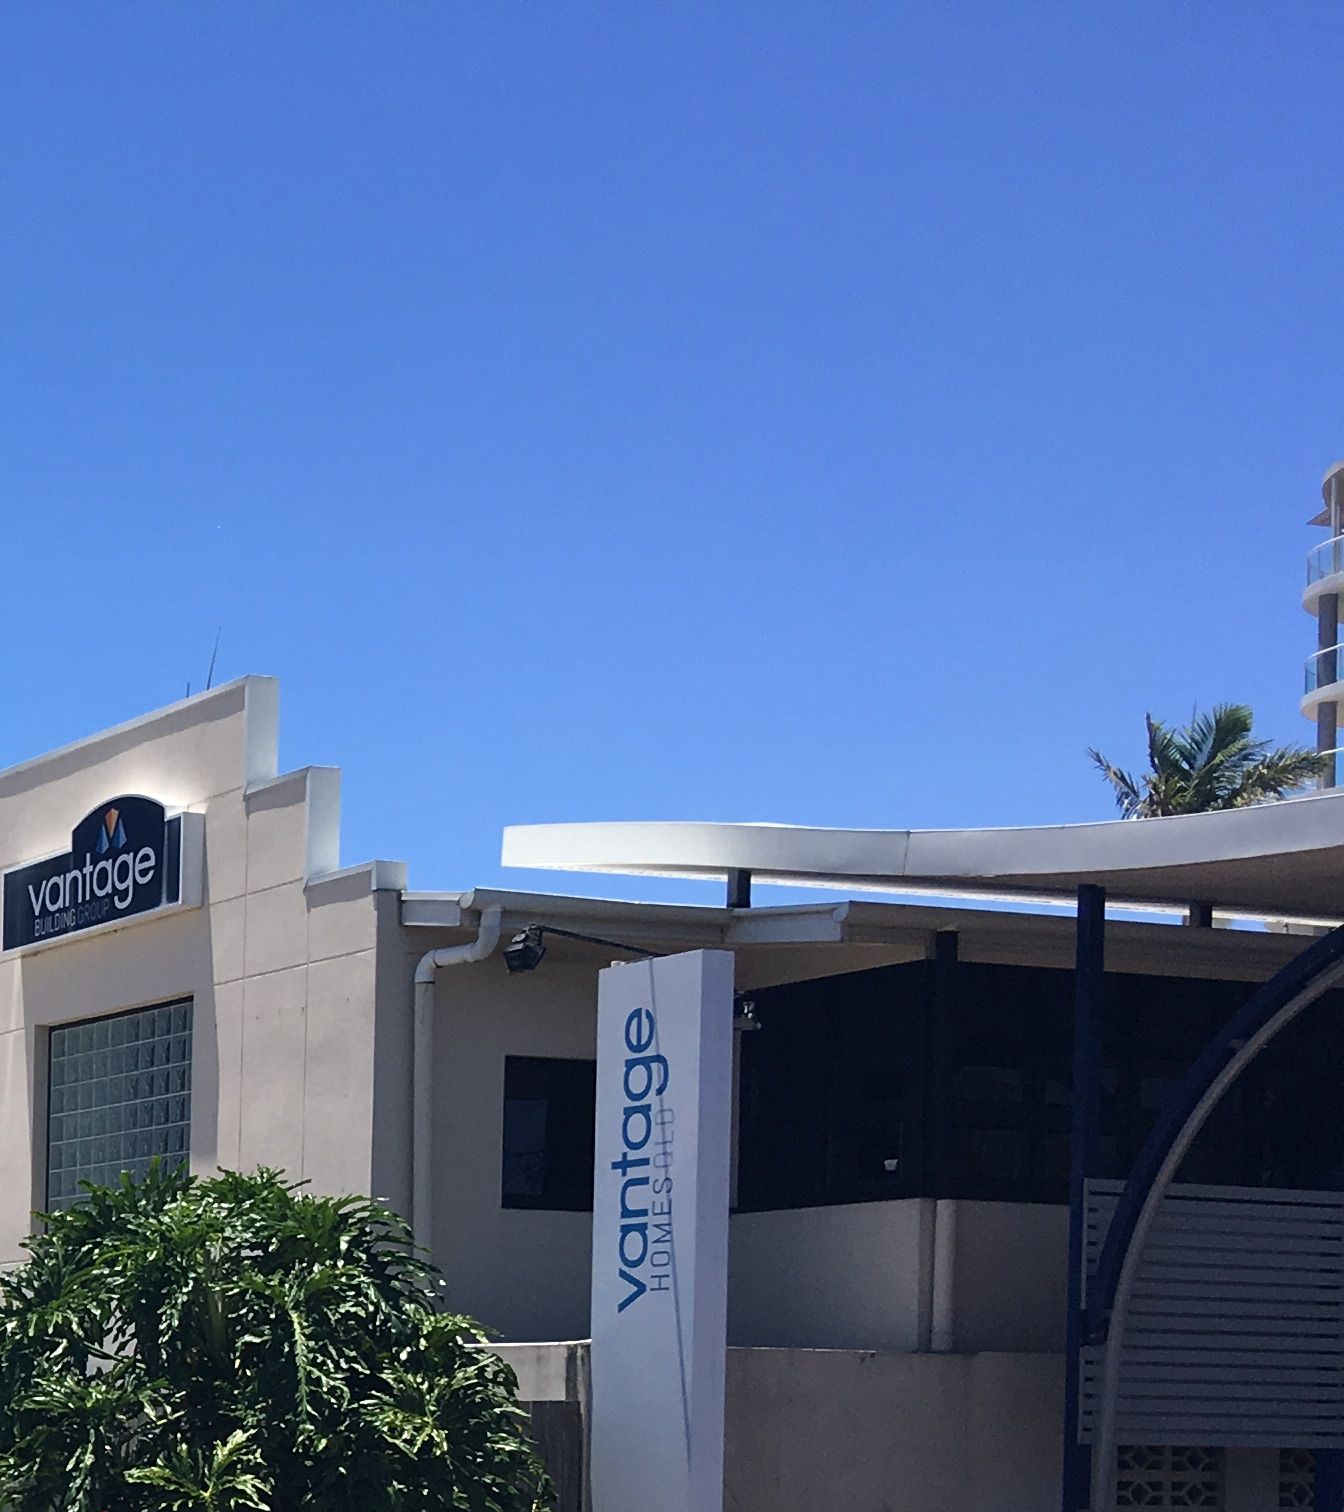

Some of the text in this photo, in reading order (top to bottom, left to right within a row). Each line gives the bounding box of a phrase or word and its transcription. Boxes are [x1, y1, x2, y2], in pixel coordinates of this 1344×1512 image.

[27, 846, 156, 916] vantage
[34, 898, 110, 937] BUILDING GROUP
[611, 1007, 670, 1313] vantage
[650, 1177, 673, 1292] HOMES
